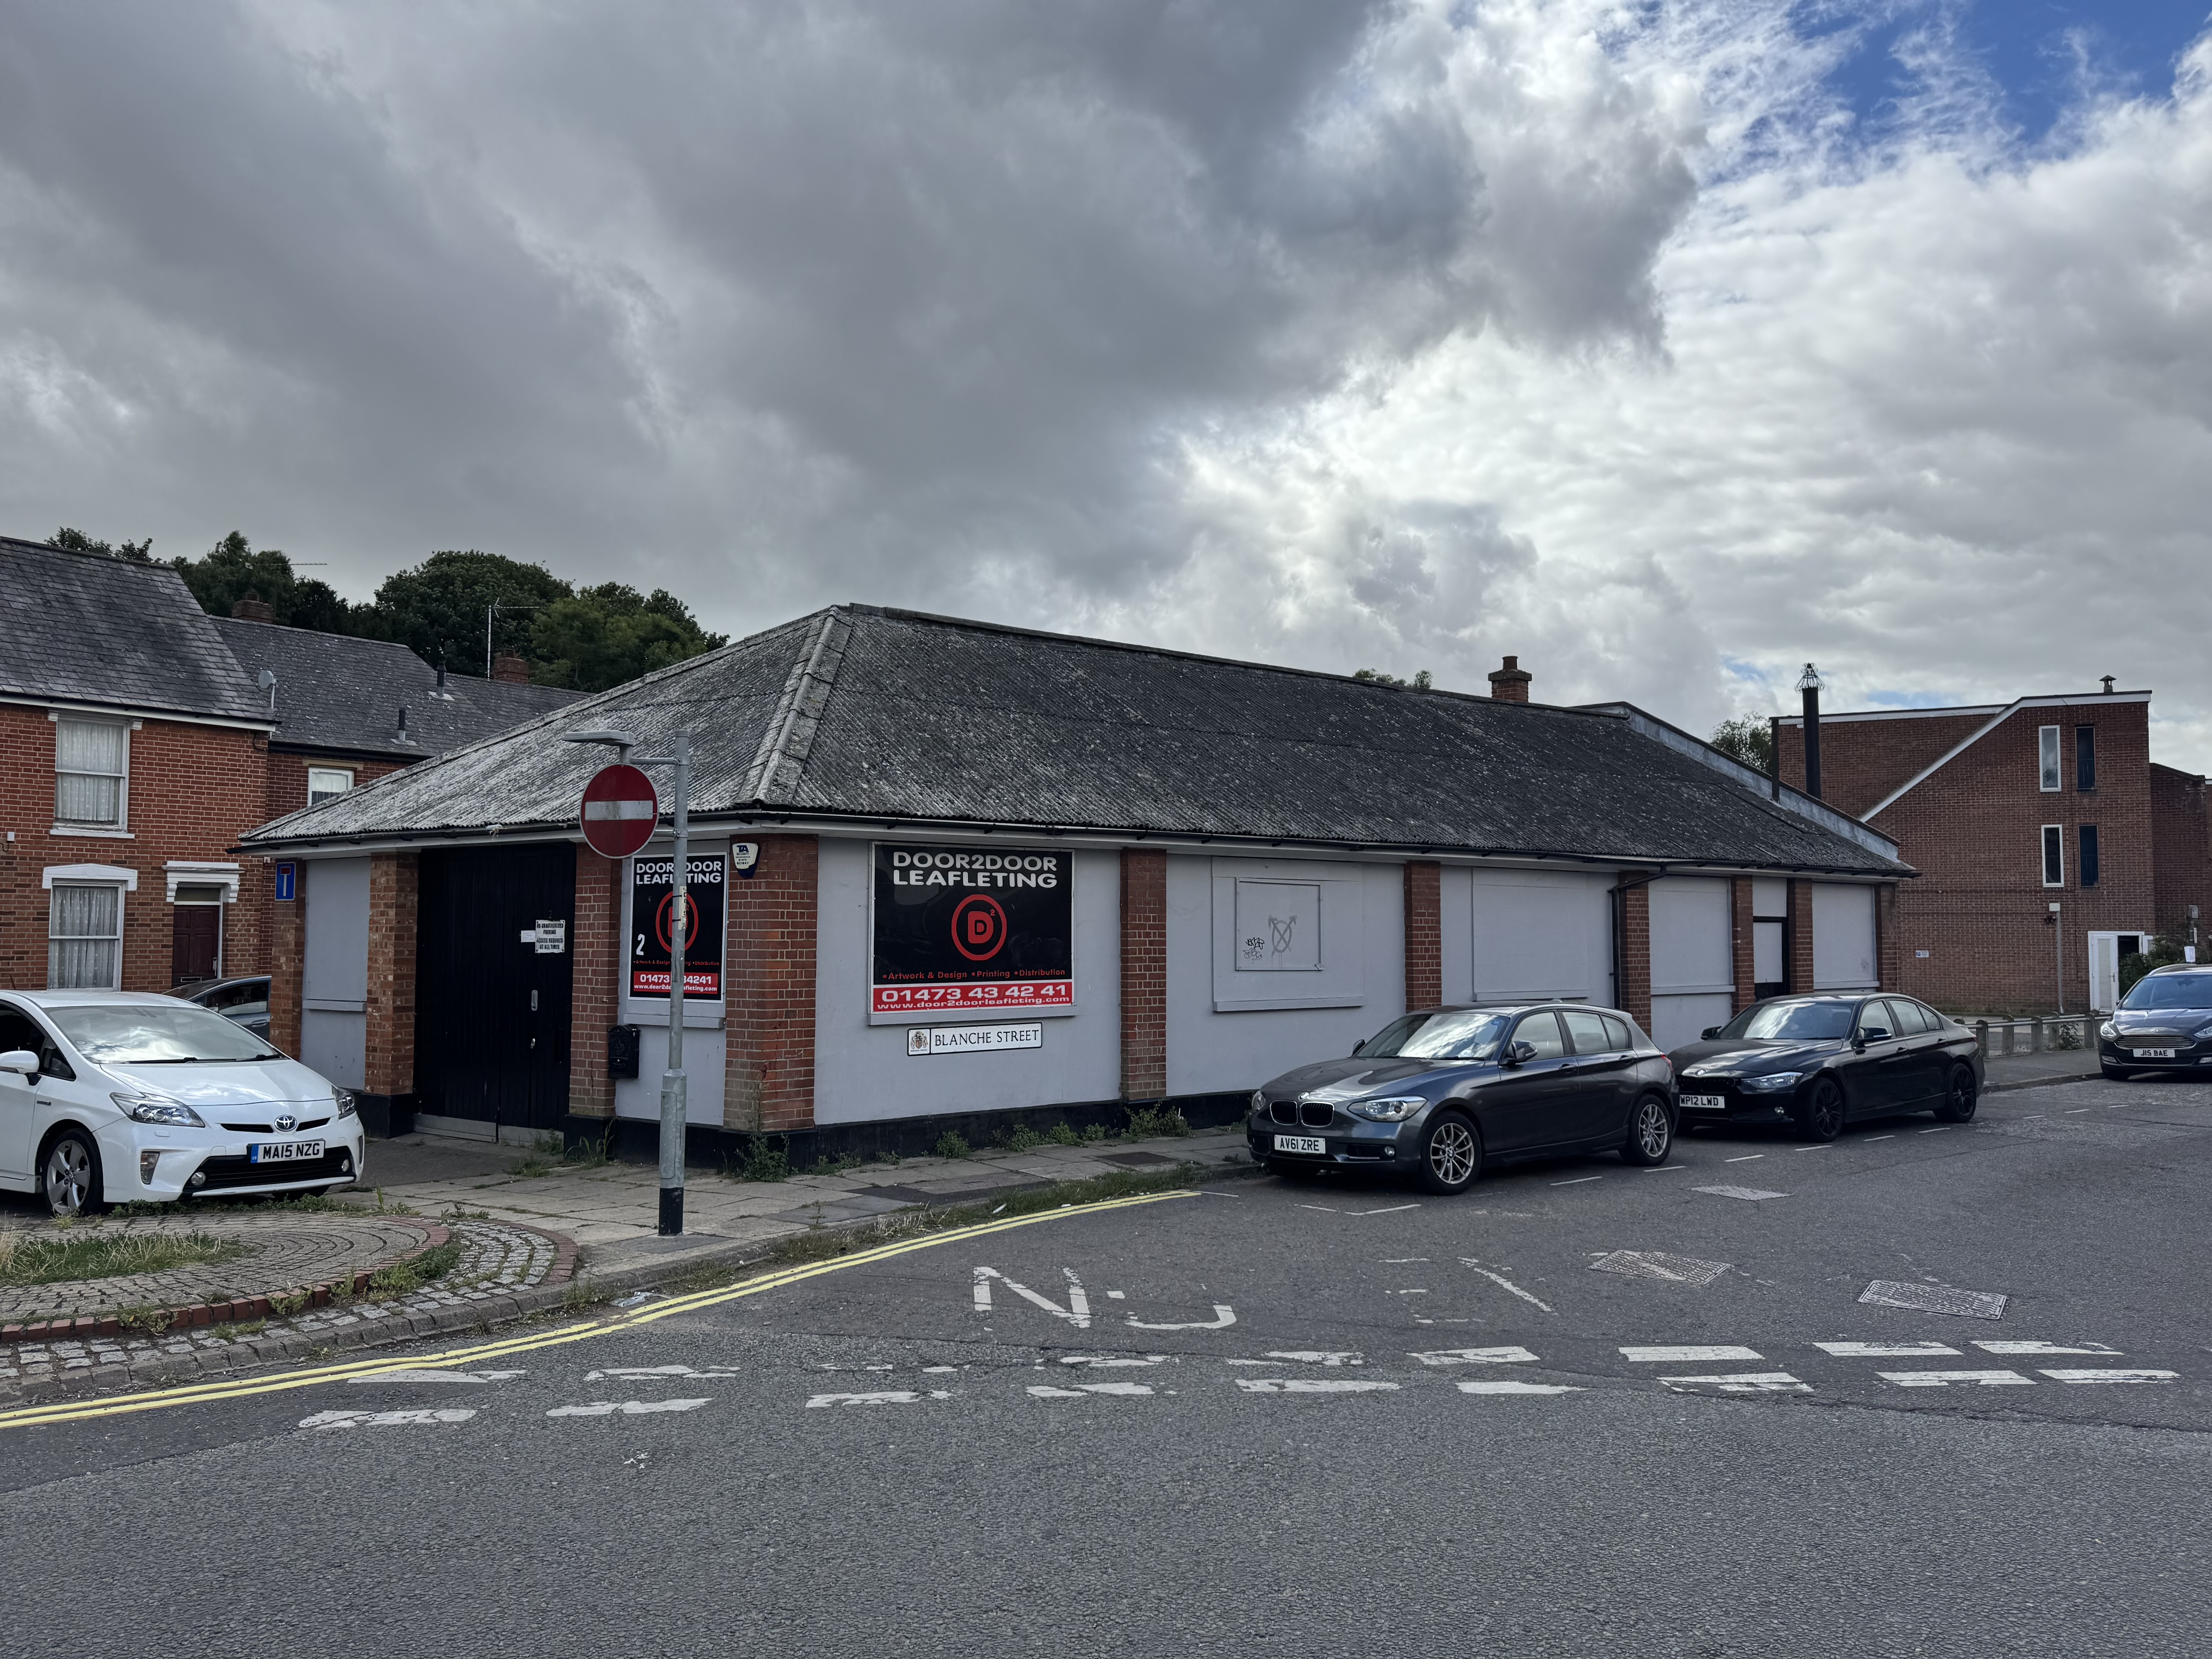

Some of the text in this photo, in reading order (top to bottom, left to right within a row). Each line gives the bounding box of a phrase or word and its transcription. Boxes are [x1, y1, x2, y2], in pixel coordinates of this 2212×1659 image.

[636, 861, 722, 873] DOORDOOR
[893, 852, 1056, 871] DOOR2DOOR
[636, 872, 721, 884] LEAFLTING
[893, 870, 1057, 888] LEAFLETING
[636, 934, 645, 956] 2
[640, 974, 670, 982] 01473
[882, 985, 1065, 1002] 01473 43 42 41
[878, 997, 1069, 1009] www.door2doorleafleting.com
[935, 1030, 1039, 1046] BLANCHE STREET
[1681, 1096, 1718, 1106] WP12 LWD
[263, 1143, 320, 1159] MA15 NZG
[1280, 1137, 1319, 1151] AV61 ZRE
